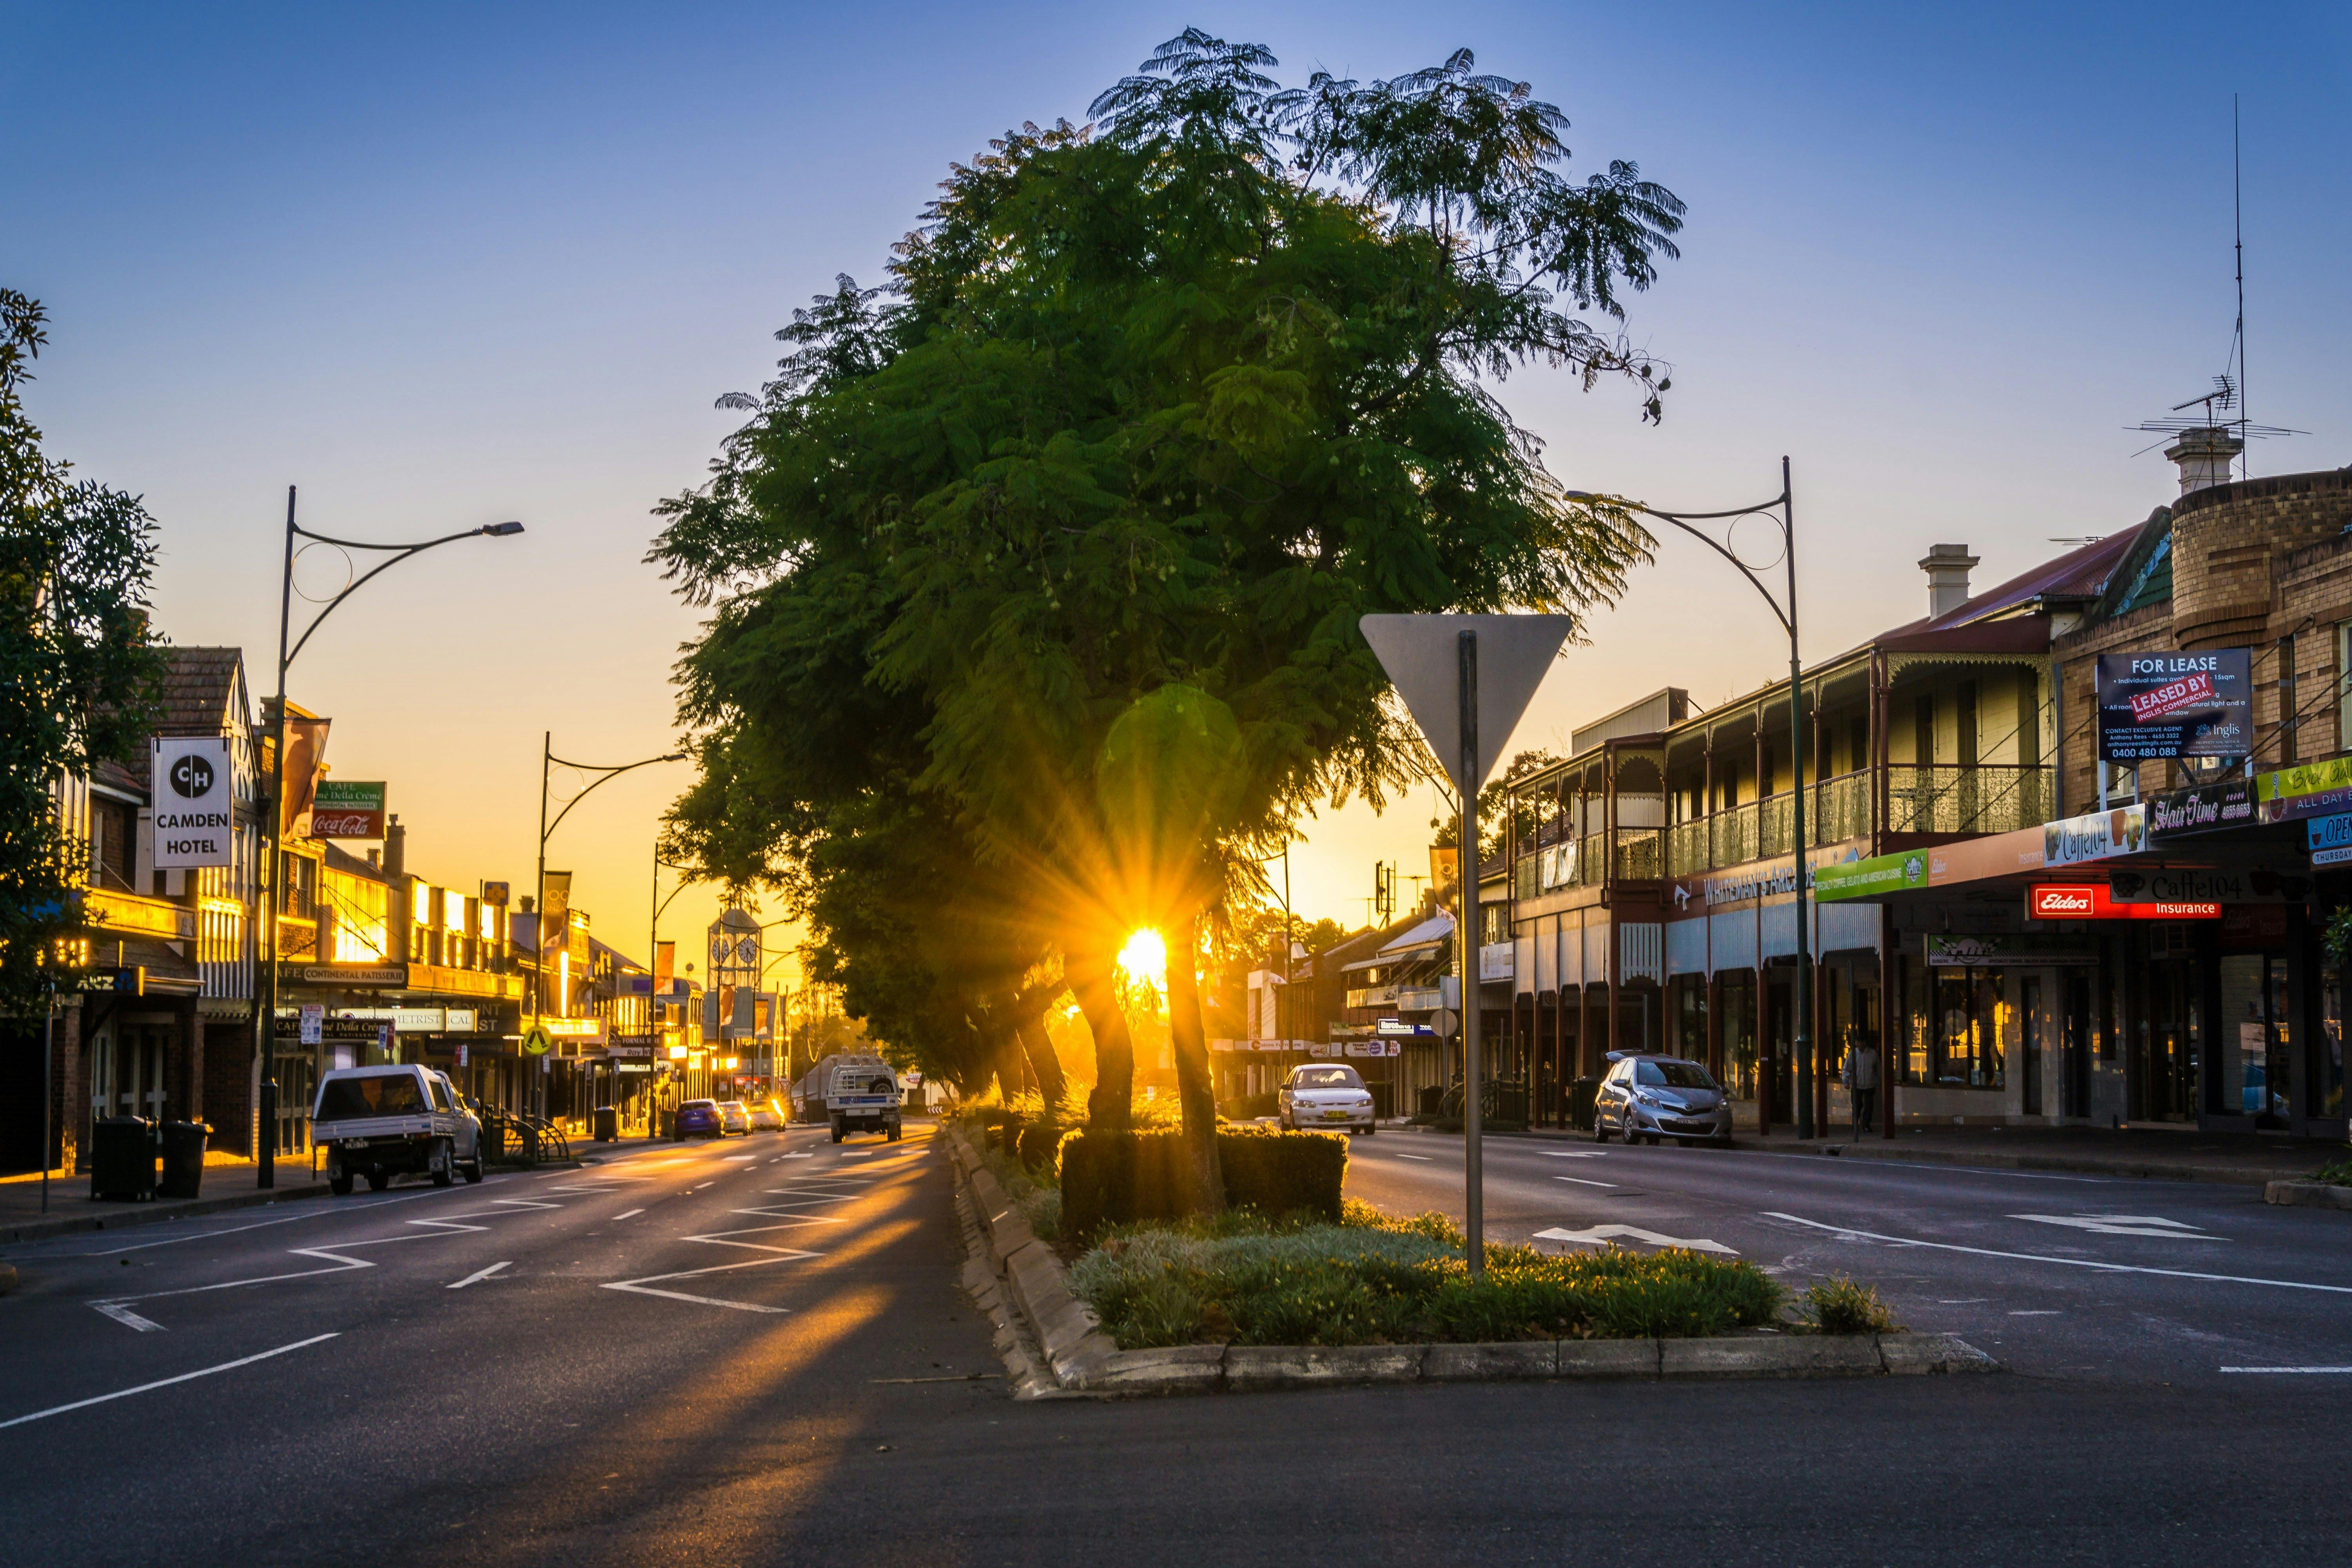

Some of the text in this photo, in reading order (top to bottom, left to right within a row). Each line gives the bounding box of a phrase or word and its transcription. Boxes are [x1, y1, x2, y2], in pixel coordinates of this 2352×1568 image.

[2132, 657, 2217, 673] FOR LEASE
[2132, 674, 2207, 713] LEASED BY
[2137, 708, 2161, 721] INGLIS
[2163, 690, 2212, 711] COMMERCIAL
[2214, 723, 2240, 738] Inglis
[2112, 747, 2177, 757] 0400 480 088
[2293, 771, 2325, 789] Back
[331, 791, 353, 800] Della
[2297, 797, 2317, 809] ALL
[2322, 792, 2345, 805] DAY
[2155, 791, 2218, 831] Hair Time
[157, 813, 228, 828] CAMDEN
[312, 815, 370, 835] Coca-Cola
[167, 839, 218, 854] HOTEL
[2018, 851, 2043, 865] Insurance
[2316, 849, 2352, 862] THURSDAY
[1704, 867, 1767, 906] WHITEMAN'S
[1816, 880, 1833, 891] SPECIALTY
[1847, 875, 1860, 886] GELATO
[1868, 869, 1886, 882] AMERICAN
[1887, 867, 1902, 880] CUISINE
[2151, 871, 2242, 902] Caffe104
[2040, 893, 2089, 910] Elders
[2156, 903, 2216, 914] Insurance
[305, 969, 358, 980] CONTINENTAL
[361, 971, 403, 980] PATISSERIE
[336, 1020, 359, 1032] Della
